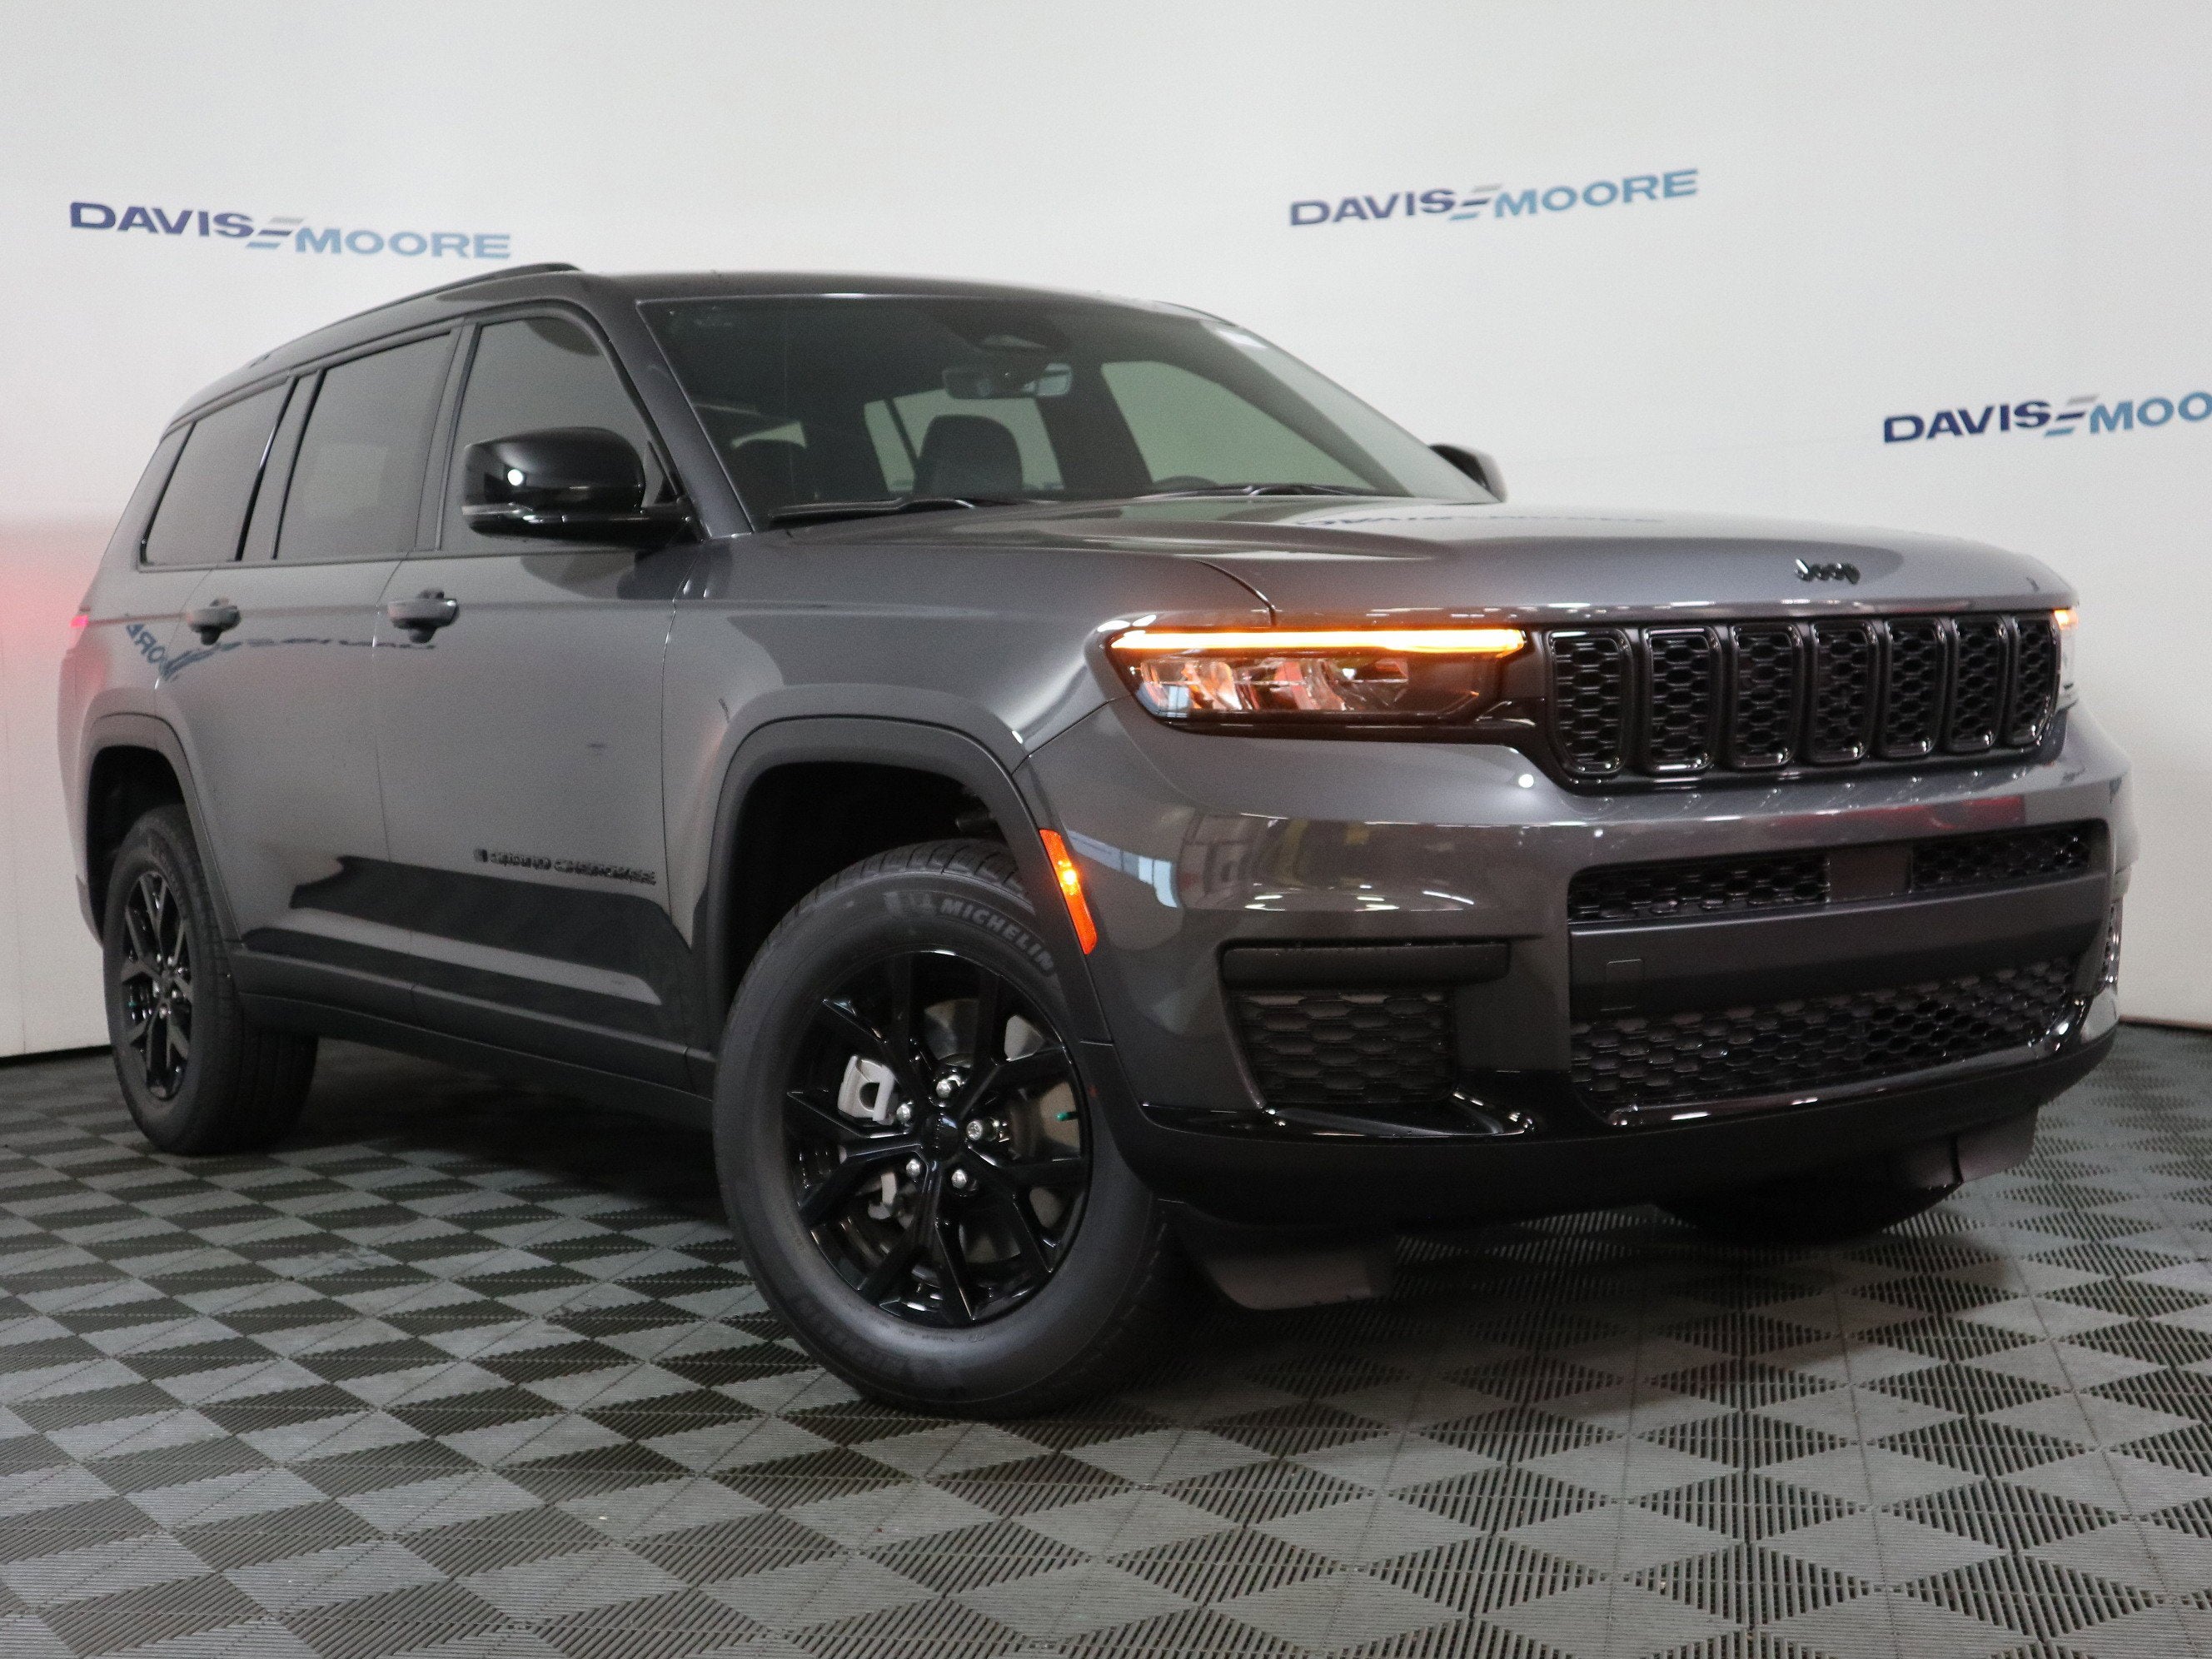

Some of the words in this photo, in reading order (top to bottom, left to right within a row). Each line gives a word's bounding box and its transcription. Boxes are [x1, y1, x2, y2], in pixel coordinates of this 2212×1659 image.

[1289, 187, 1456, 227] DAVIS
[1495, 168, 1699, 219] MOORE
[70, 201, 254, 238] DAVIS
[294, 227, 511, 260] MOORE
[1884, 400, 2051, 443] DAVIS
[939, 898, 1054, 972] MICHELIN
